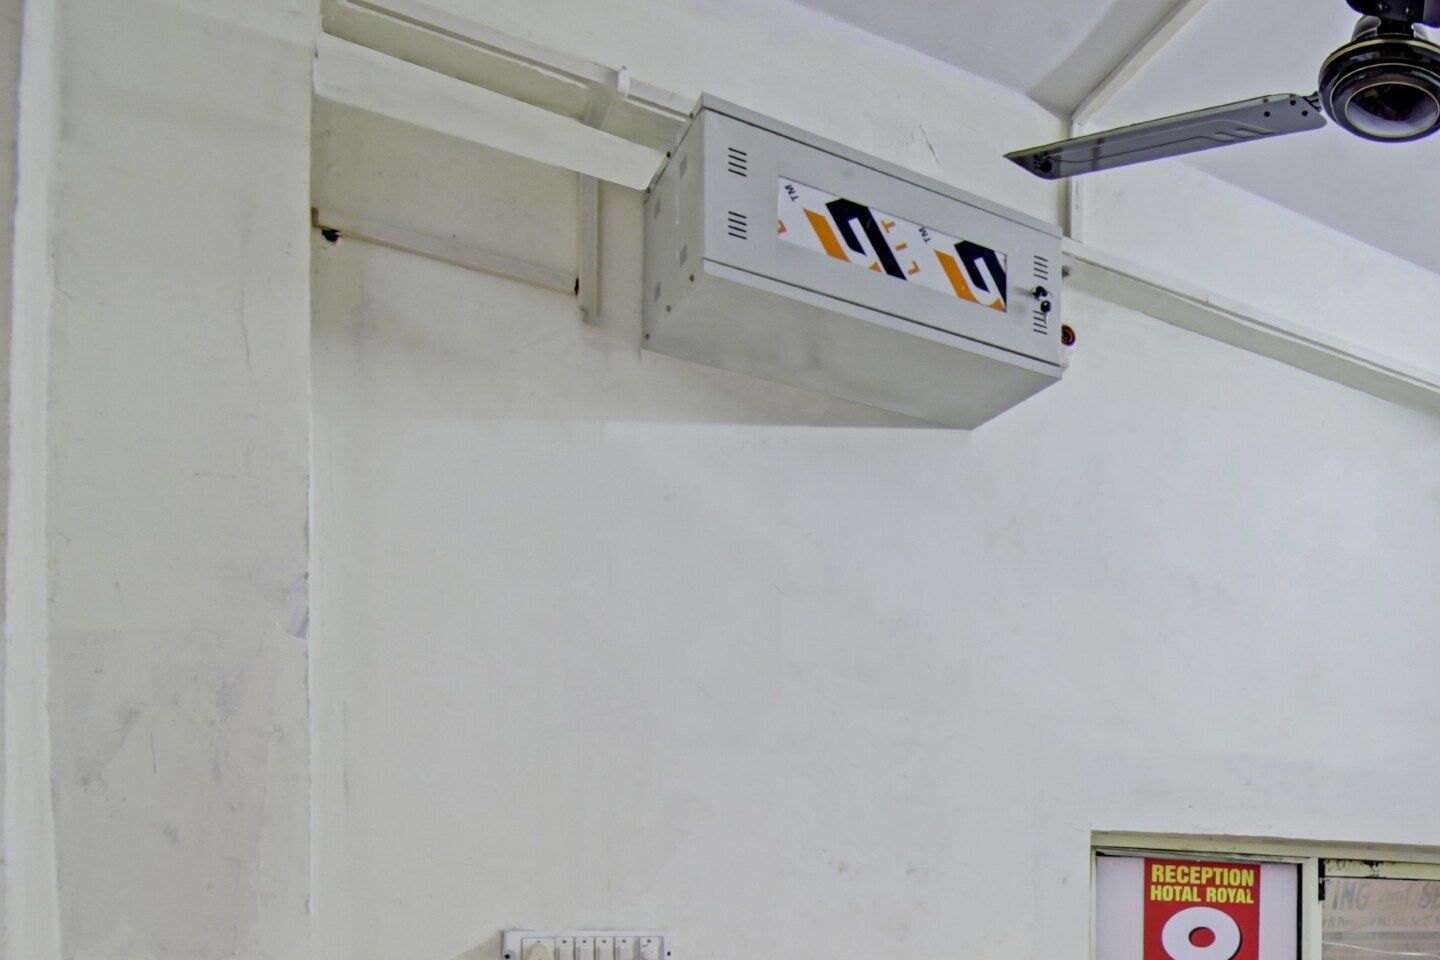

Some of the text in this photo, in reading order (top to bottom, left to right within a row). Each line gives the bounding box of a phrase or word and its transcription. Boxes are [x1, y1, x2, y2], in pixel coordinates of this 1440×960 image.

[1151, 864, 1254, 887] RECEPTION
[1150, 884, 1254, 904] HOTAL ROYAL
